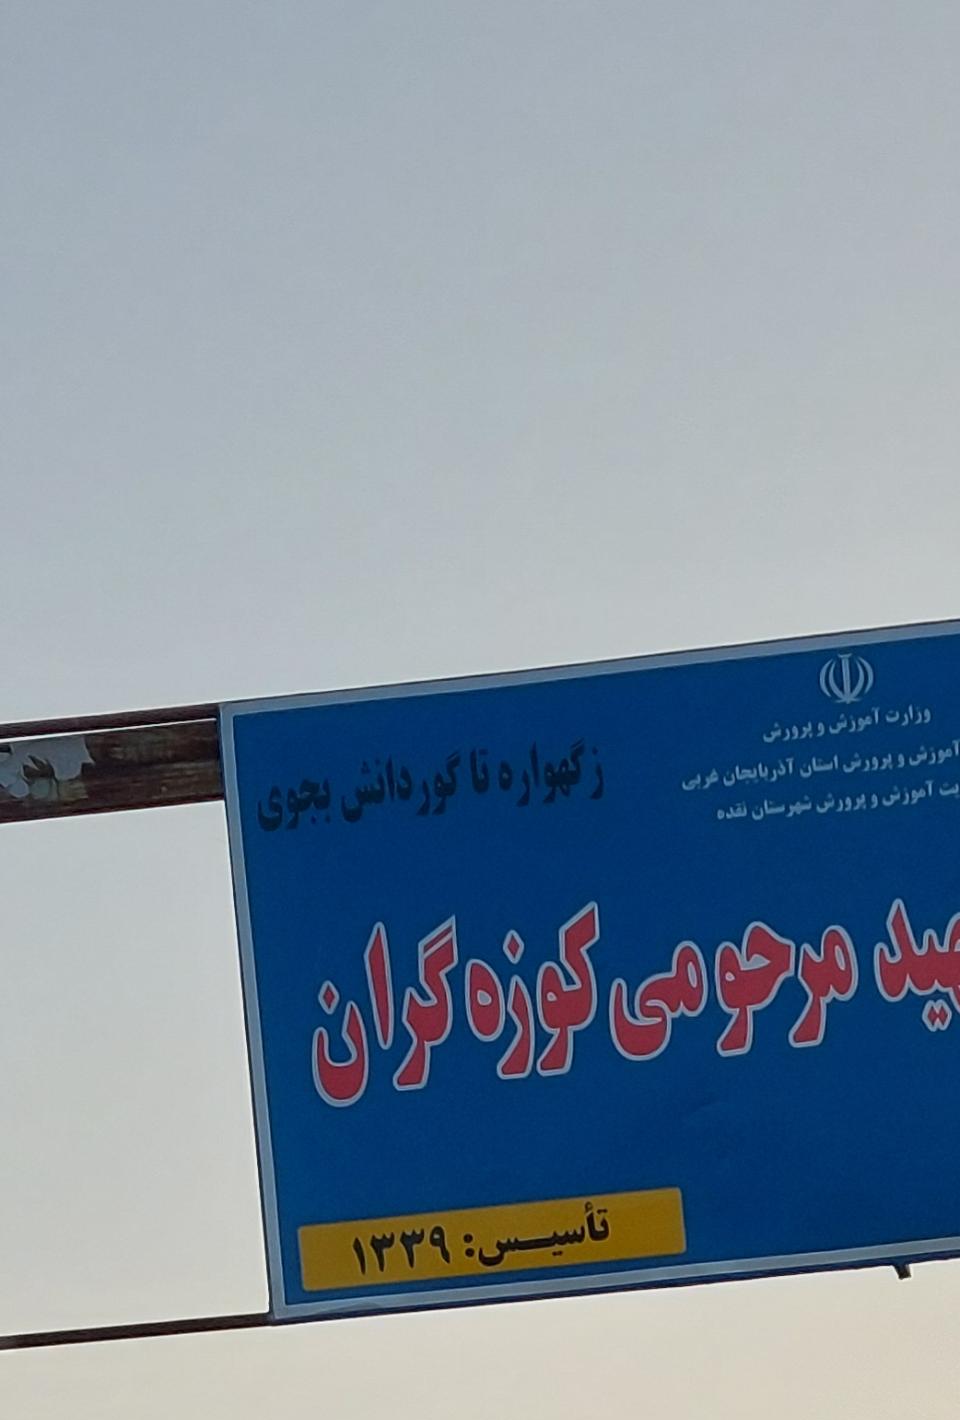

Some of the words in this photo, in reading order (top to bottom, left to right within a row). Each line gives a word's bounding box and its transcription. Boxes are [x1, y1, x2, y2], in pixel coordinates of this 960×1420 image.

[829, 706, 879, 734] آموزش
[885, 704, 931, 725] وزارت
[763, 720, 812, 743] پرورش
[816, 723, 825, 737] و
[843, 752, 893, 773] پرورش
[909, 740, 960, 767] آموزش
[469, 748, 490, 795] تا
[723, 757, 793, 786] آذربایجان
[800, 755, 839, 778] استان
[682, 768, 719, 791] غربی
[257, 776, 332, 832] بجوی
[816, 789, 866, 813] پرورش
[883, 781, 933, 806] آموزش
[717, 802, 747, 820] نقده
[752, 795, 811, 820] شهرستان
[351, 1225, 451, 1276] ۱۳۳۹
